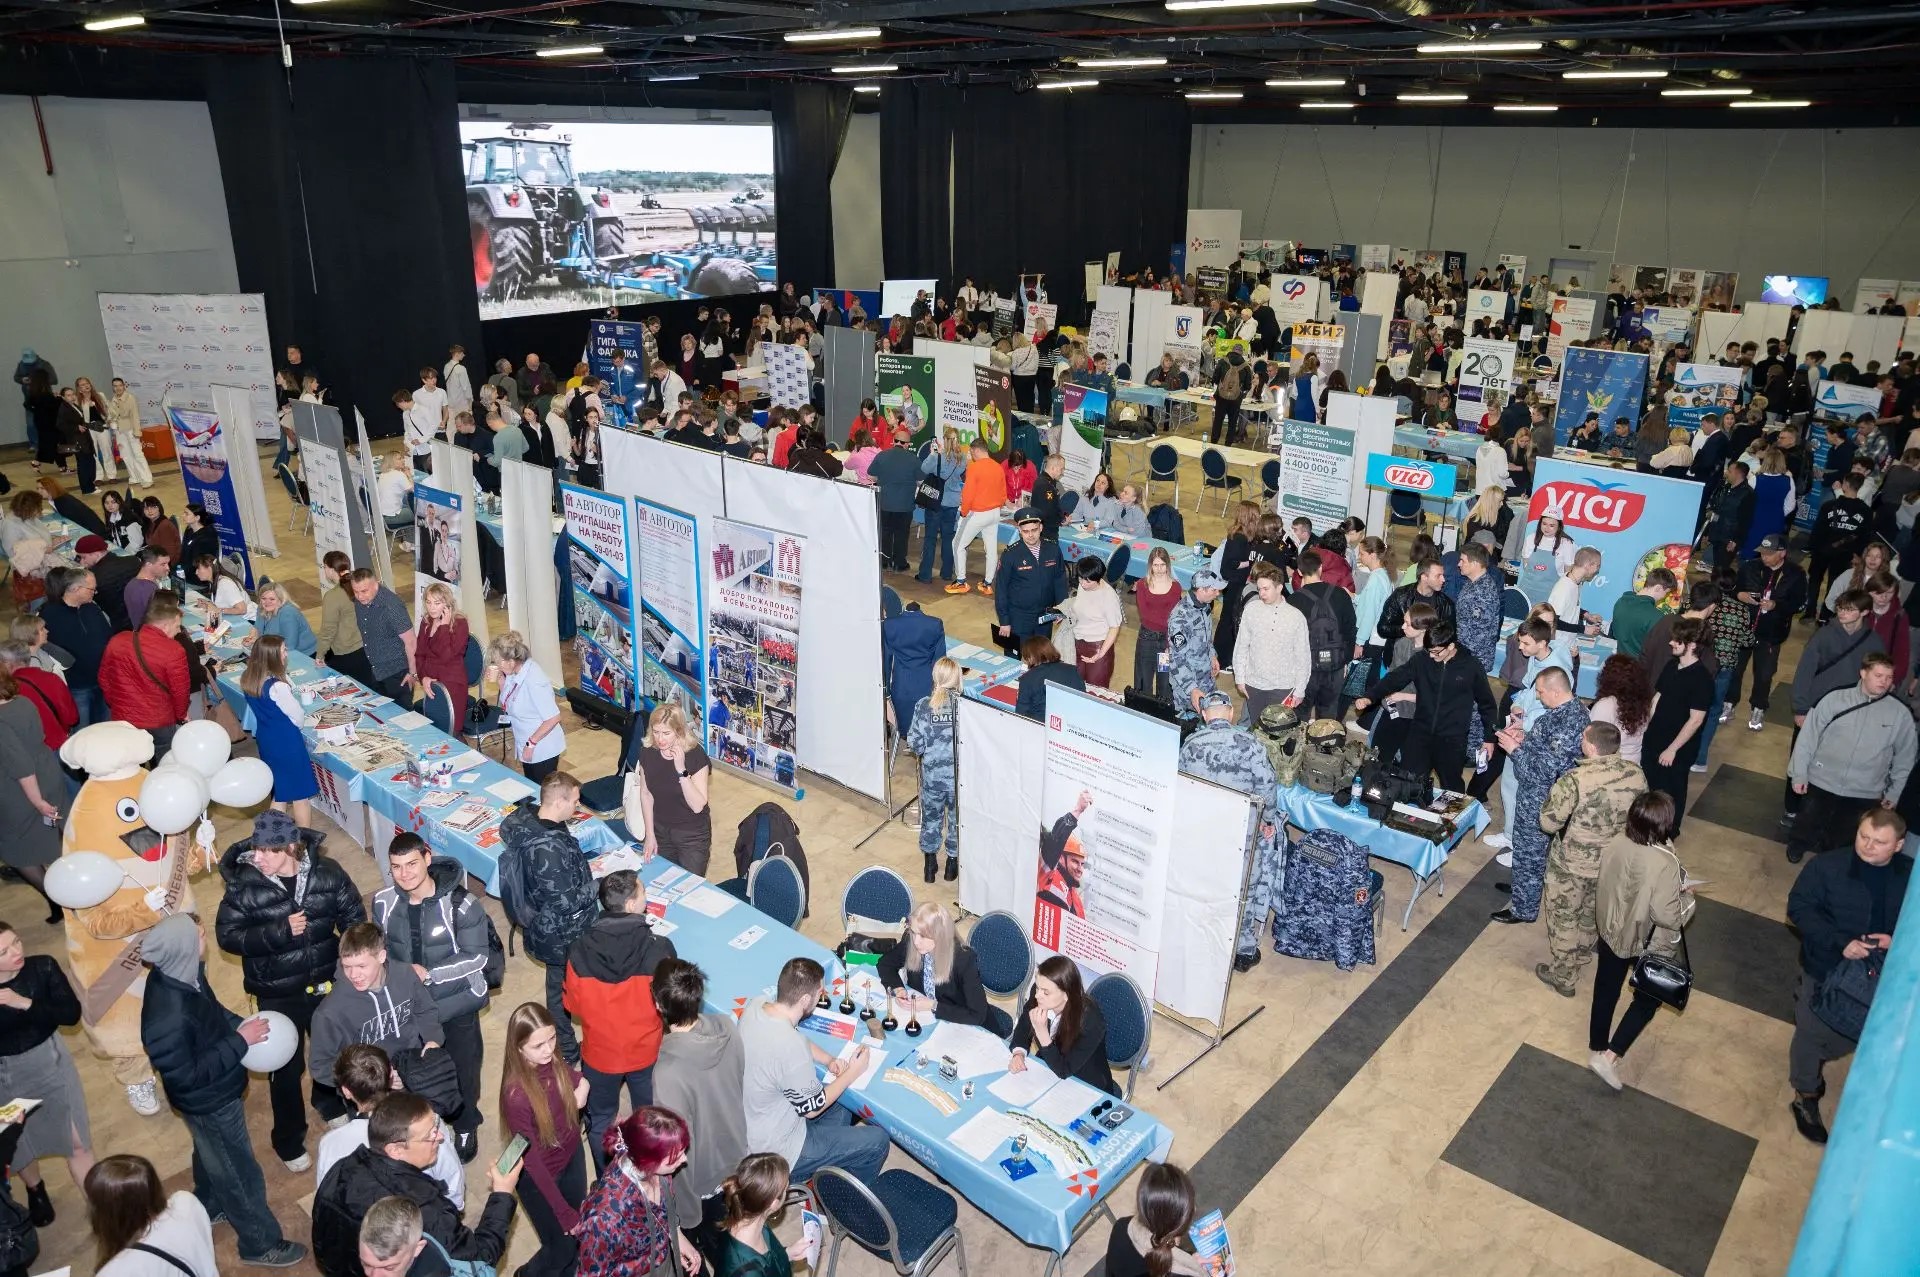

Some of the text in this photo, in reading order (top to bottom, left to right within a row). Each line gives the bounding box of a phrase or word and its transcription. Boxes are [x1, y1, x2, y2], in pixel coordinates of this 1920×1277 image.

[1299, 324, 1344, 337] ЖБИ 2
[597, 337, 617, 347] ГИГА
[597, 347, 639, 359] ФАКА
[943, 398, 978, 411] ЭКОНОМЬТЕ
[948, 407, 972, 417] КАРТОЙ
[943, 413, 975, 424] АПЕЛЬСИН
[1302, 427, 1330, 436] ВОЙСКА
[1292, 460, 1310, 470] 400
[1311, 463, 1330, 474] 000
[1391, 470, 1427, 487] VICI
[575, 499, 621, 520] АВТОТОР
[1546, 486, 1627, 527] VICI
[567, 510, 622, 535] ПРИГЛАШАЕТ
[649, 512, 693, 537] АВТОТОР
[578, 526, 591, 537] НА
[592, 529, 623, 548] РАБОТУ
[594, 543, 625, 562] 59-01-03
[720, 587, 799, 615] ДОБРО ПОЖАЛОВАТЬ
[729, 598, 757, 611] СЕМЬЮ
[759, 606, 794, 621] АВТОТОР
[932, 714, 953, 722] ОМО
[163, 832, 190, 910] ХЛЕБОЗАВ
[360, 998, 412, 1046] NIKE
